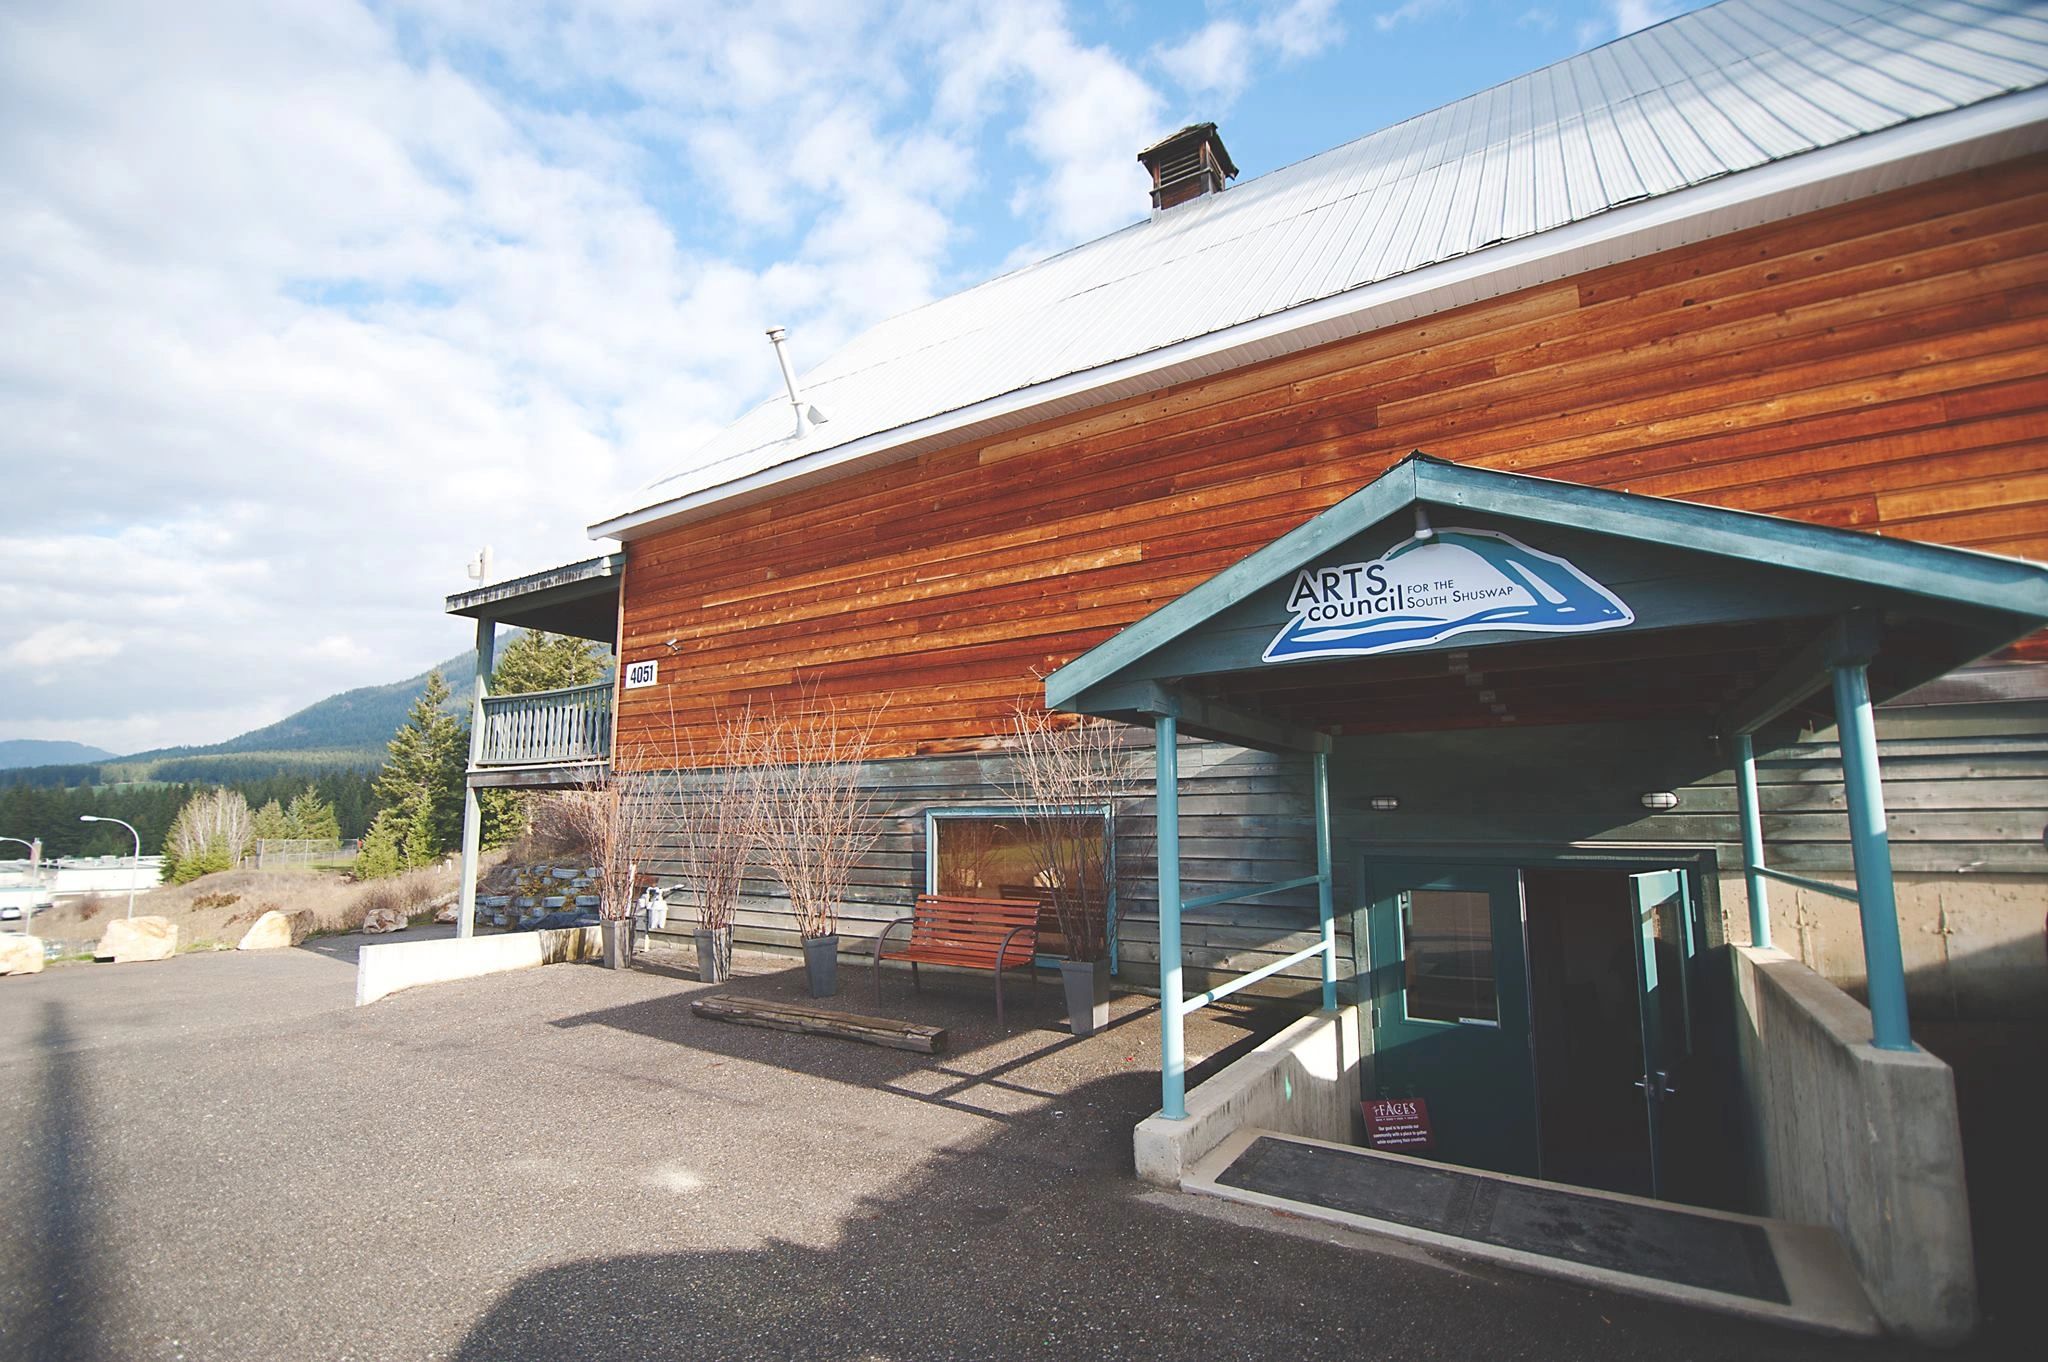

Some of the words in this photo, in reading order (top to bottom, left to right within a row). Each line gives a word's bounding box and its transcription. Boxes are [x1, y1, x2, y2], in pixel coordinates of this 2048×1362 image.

[1292, 564, 1387, 607] ARTS
[1407, 583, 1429, 594] FOR
[1434, 579, 1454, 590] THE
[1308, 584, 1403, 621] council
[630, 664, 654, 684] 4051
